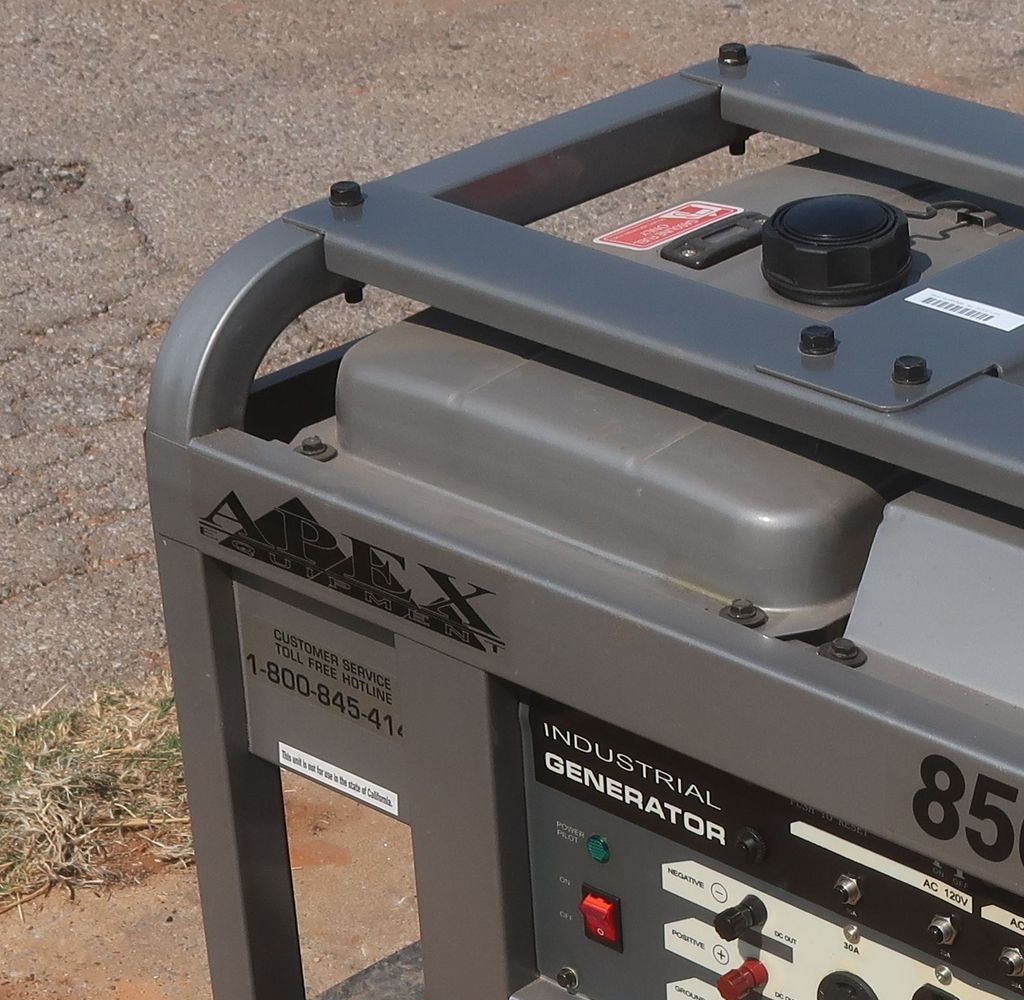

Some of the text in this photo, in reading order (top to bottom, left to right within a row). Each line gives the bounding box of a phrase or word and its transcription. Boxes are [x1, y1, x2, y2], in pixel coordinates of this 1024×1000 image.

[199, 490, 504, 641] APEX
[274, 628, 392, 691] CUSTOMER SERVICE
[275, 642, 393, 705] TOLL FREE HOTLINE
[281, 749, 292, 763] This
[292, 756, 303, 766] unit
[308, 763, 316, 773] not
[316, 766, 324, 776] for
[324, 771, 333, 781] use
[339, 775, 348, 787] the
[348, 780, 361, 793] state
[543, 722, 723, 811] INDUSTRIAL
[545, 751, 727, 846] GENERATOR
[556, 820, 585, 838] POWER
[556, 829, 578, 844] PILOT
[667, 867, 705, 889] NEGATIVE
[923, 878, 969, 908] AC 120V
[671, 929, 706, 950] POSITIVE
[774, 930, 798, 946] DC OUT
[843, 941, 861, 956] 30A
[775, 991, 785, 1000] DC
